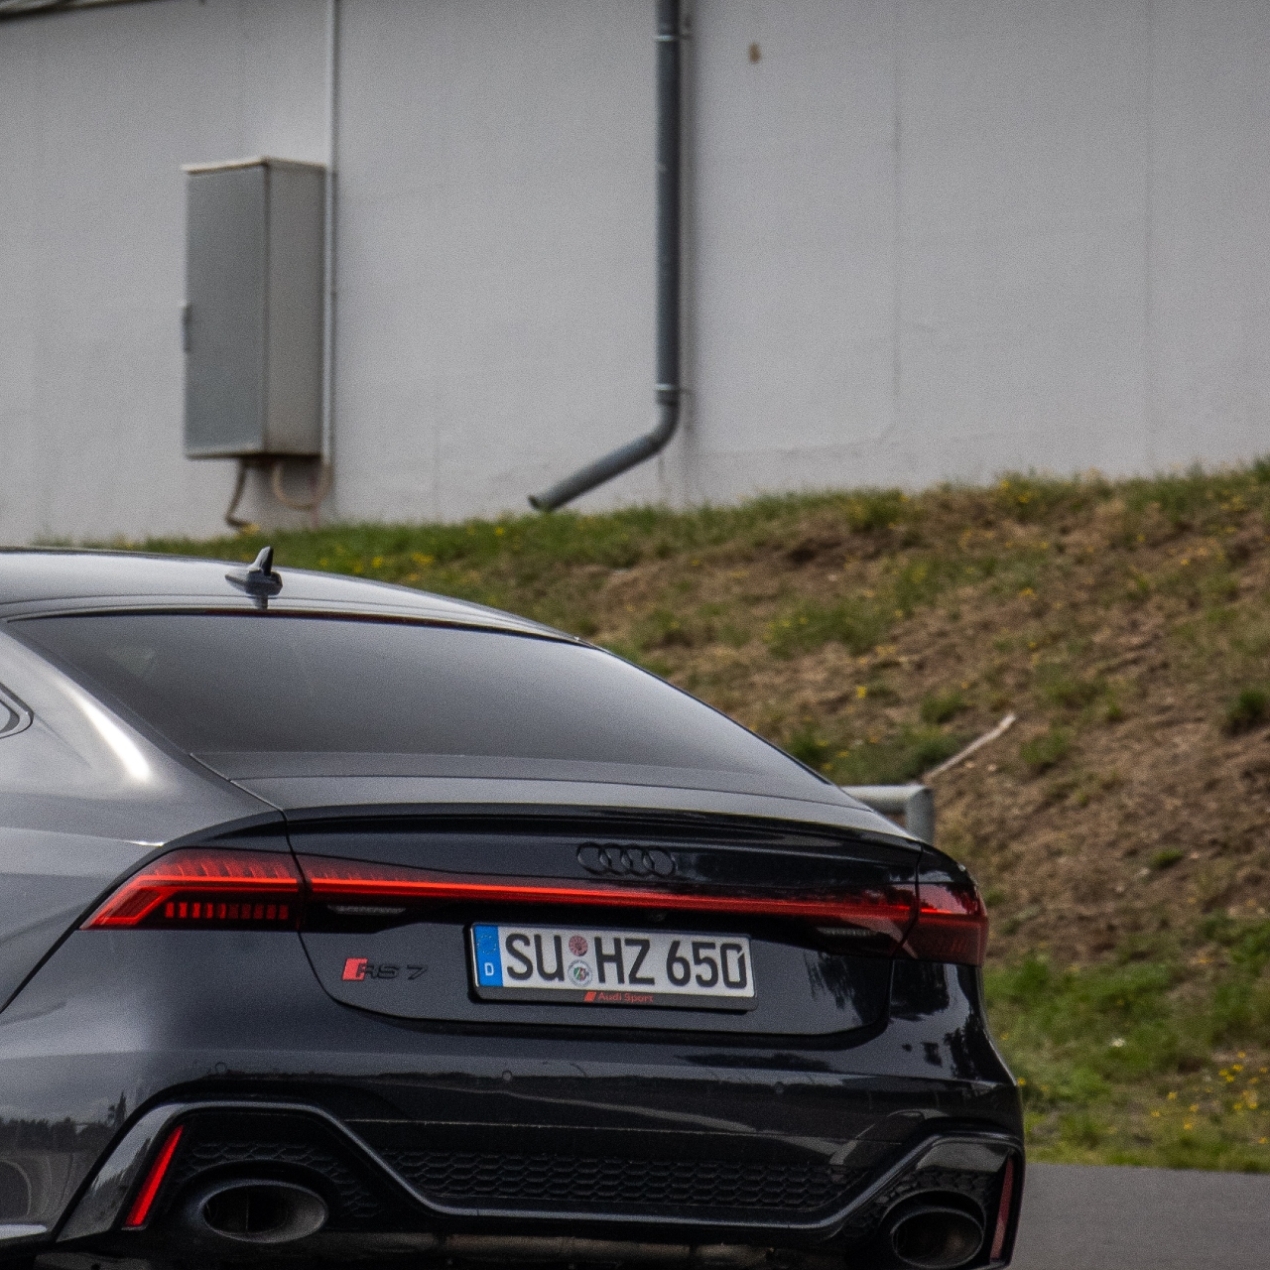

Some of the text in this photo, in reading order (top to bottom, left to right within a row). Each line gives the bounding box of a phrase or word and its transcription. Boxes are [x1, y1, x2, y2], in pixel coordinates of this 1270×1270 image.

[505, 933, 565, 982] SU
[594, 936, 655, 986] HZ
[666, 940, 748, 989] 650
[485, 962, 495, 977] D
[598, 992, 654, 1004] Audi Sport
